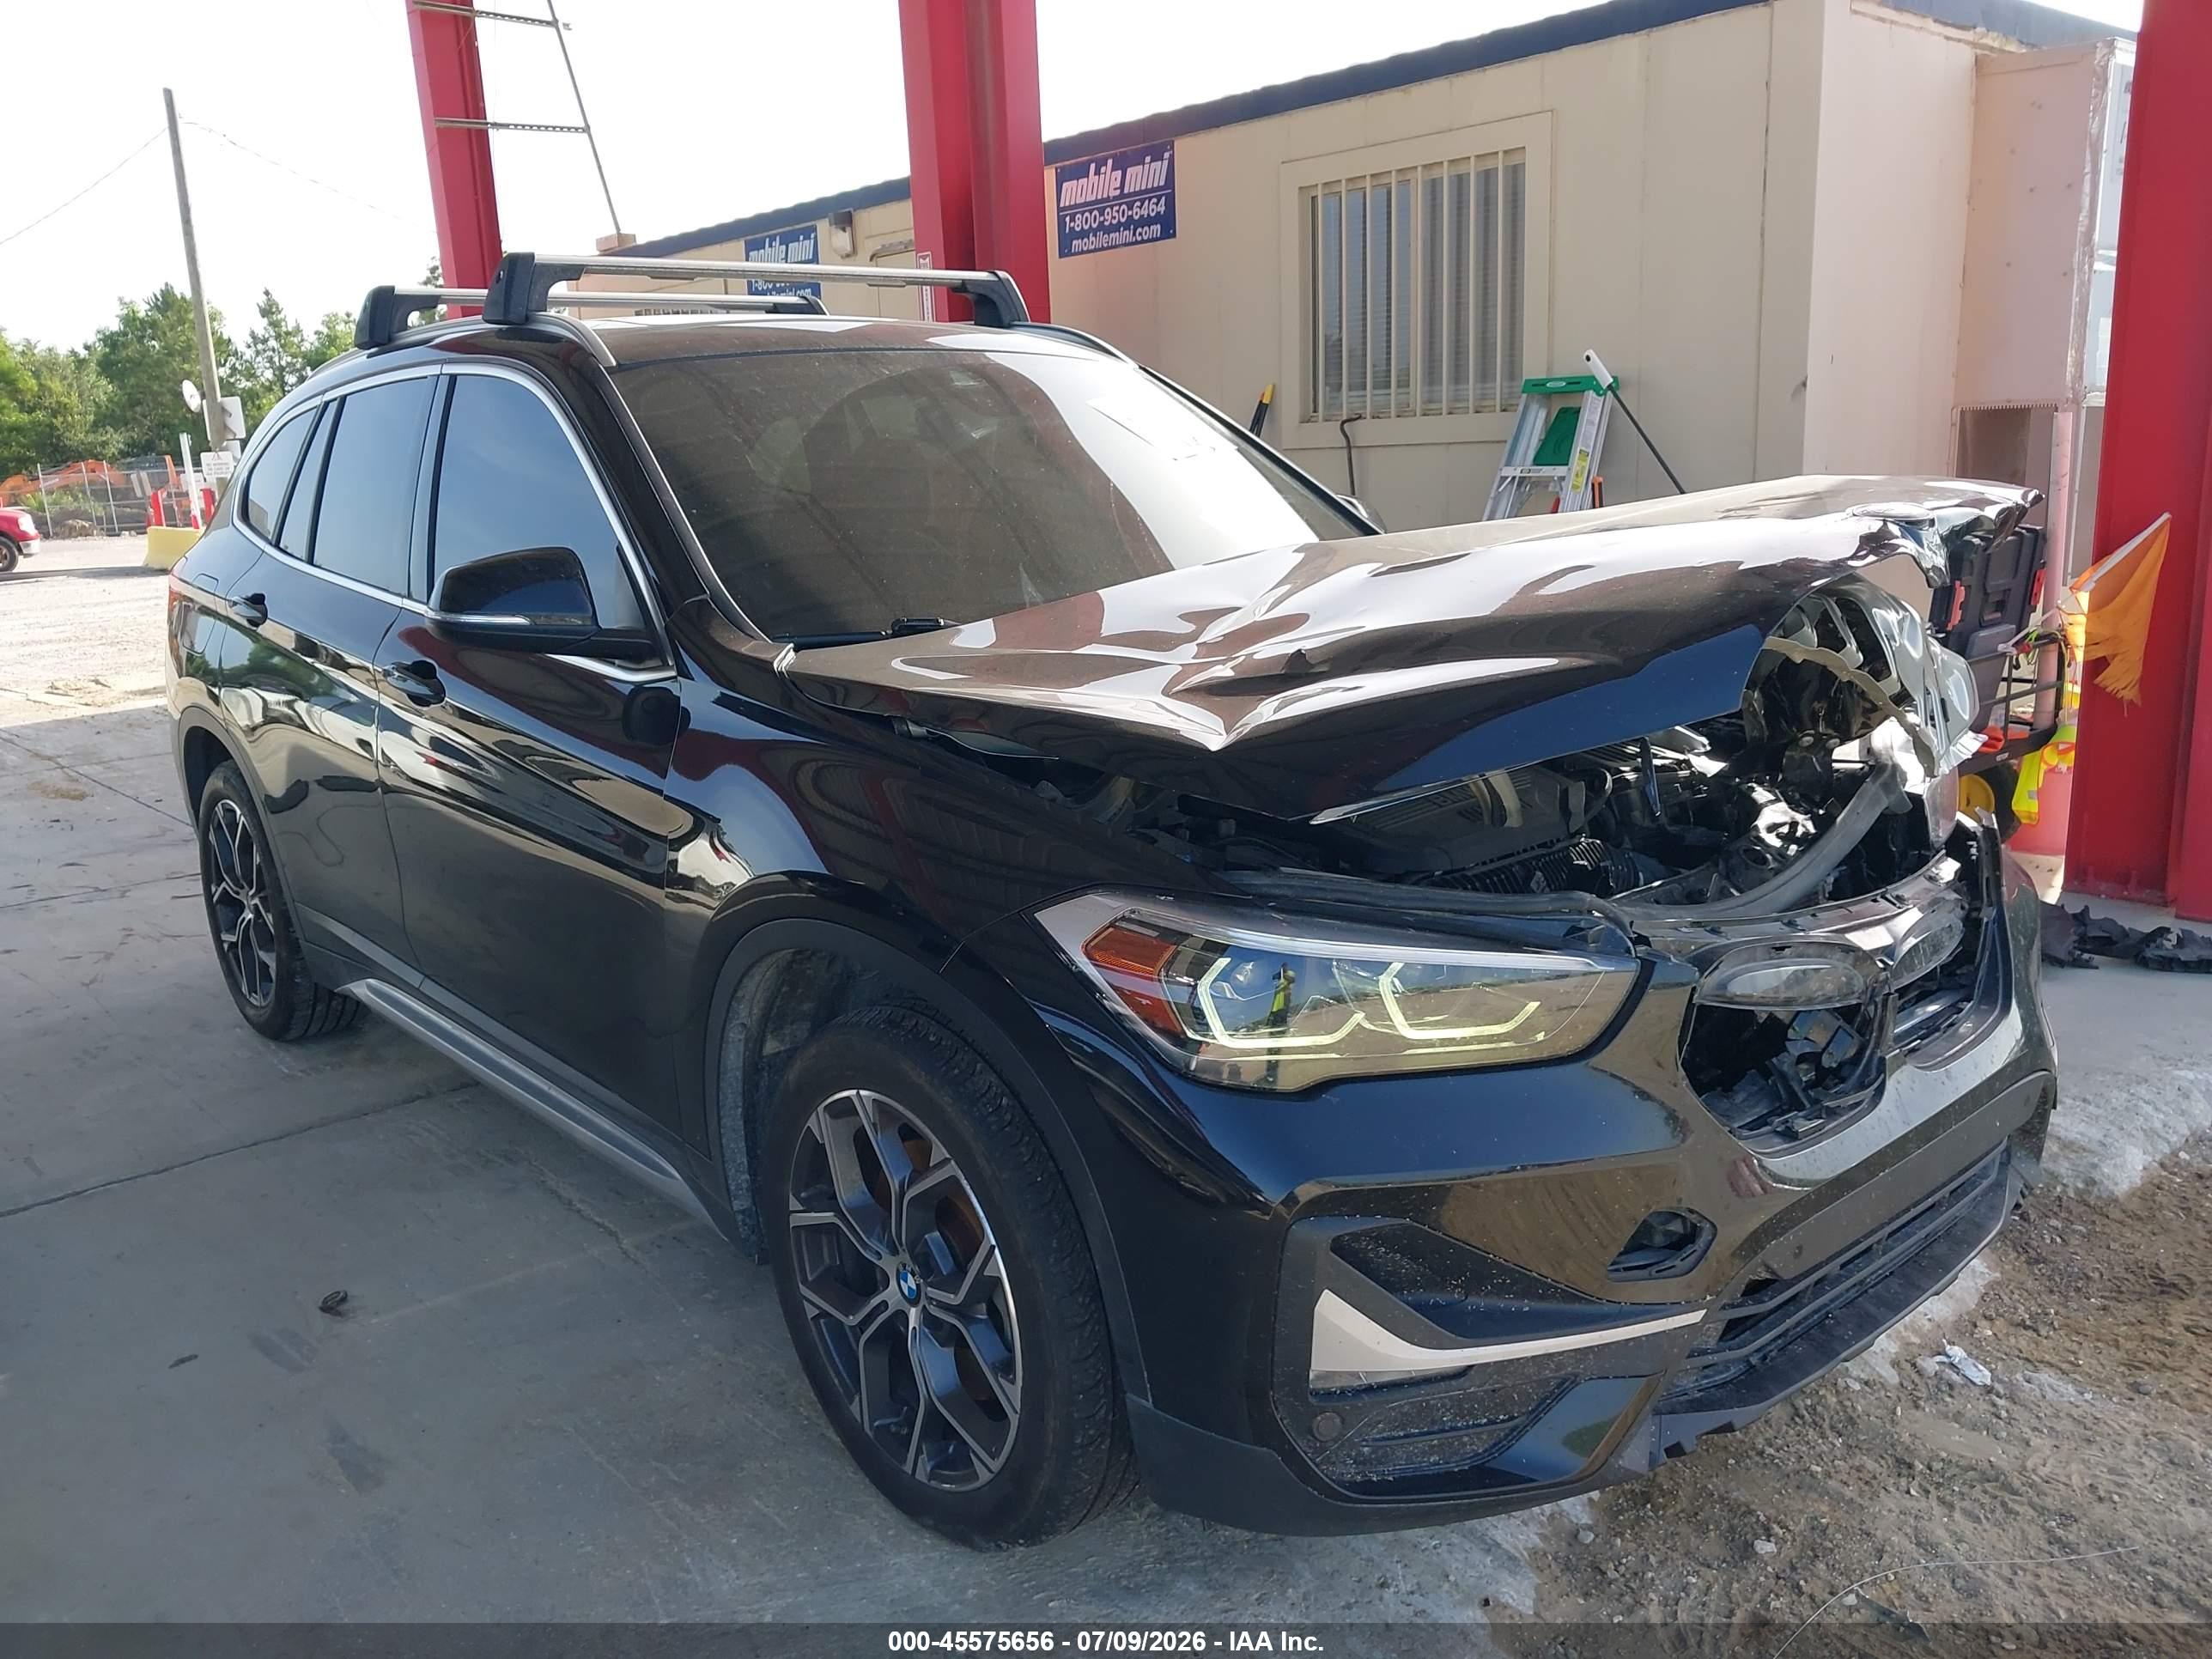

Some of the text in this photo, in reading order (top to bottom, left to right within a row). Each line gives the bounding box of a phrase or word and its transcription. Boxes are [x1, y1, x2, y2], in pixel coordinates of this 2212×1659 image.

[1060, 152, 1170, 207] mobile mini
[1065, 197, 1165, 234] 1-800-950-6464
[787, 233, 815, 263] mini
[1072, 223, 1161, 252] mobilemini.com
